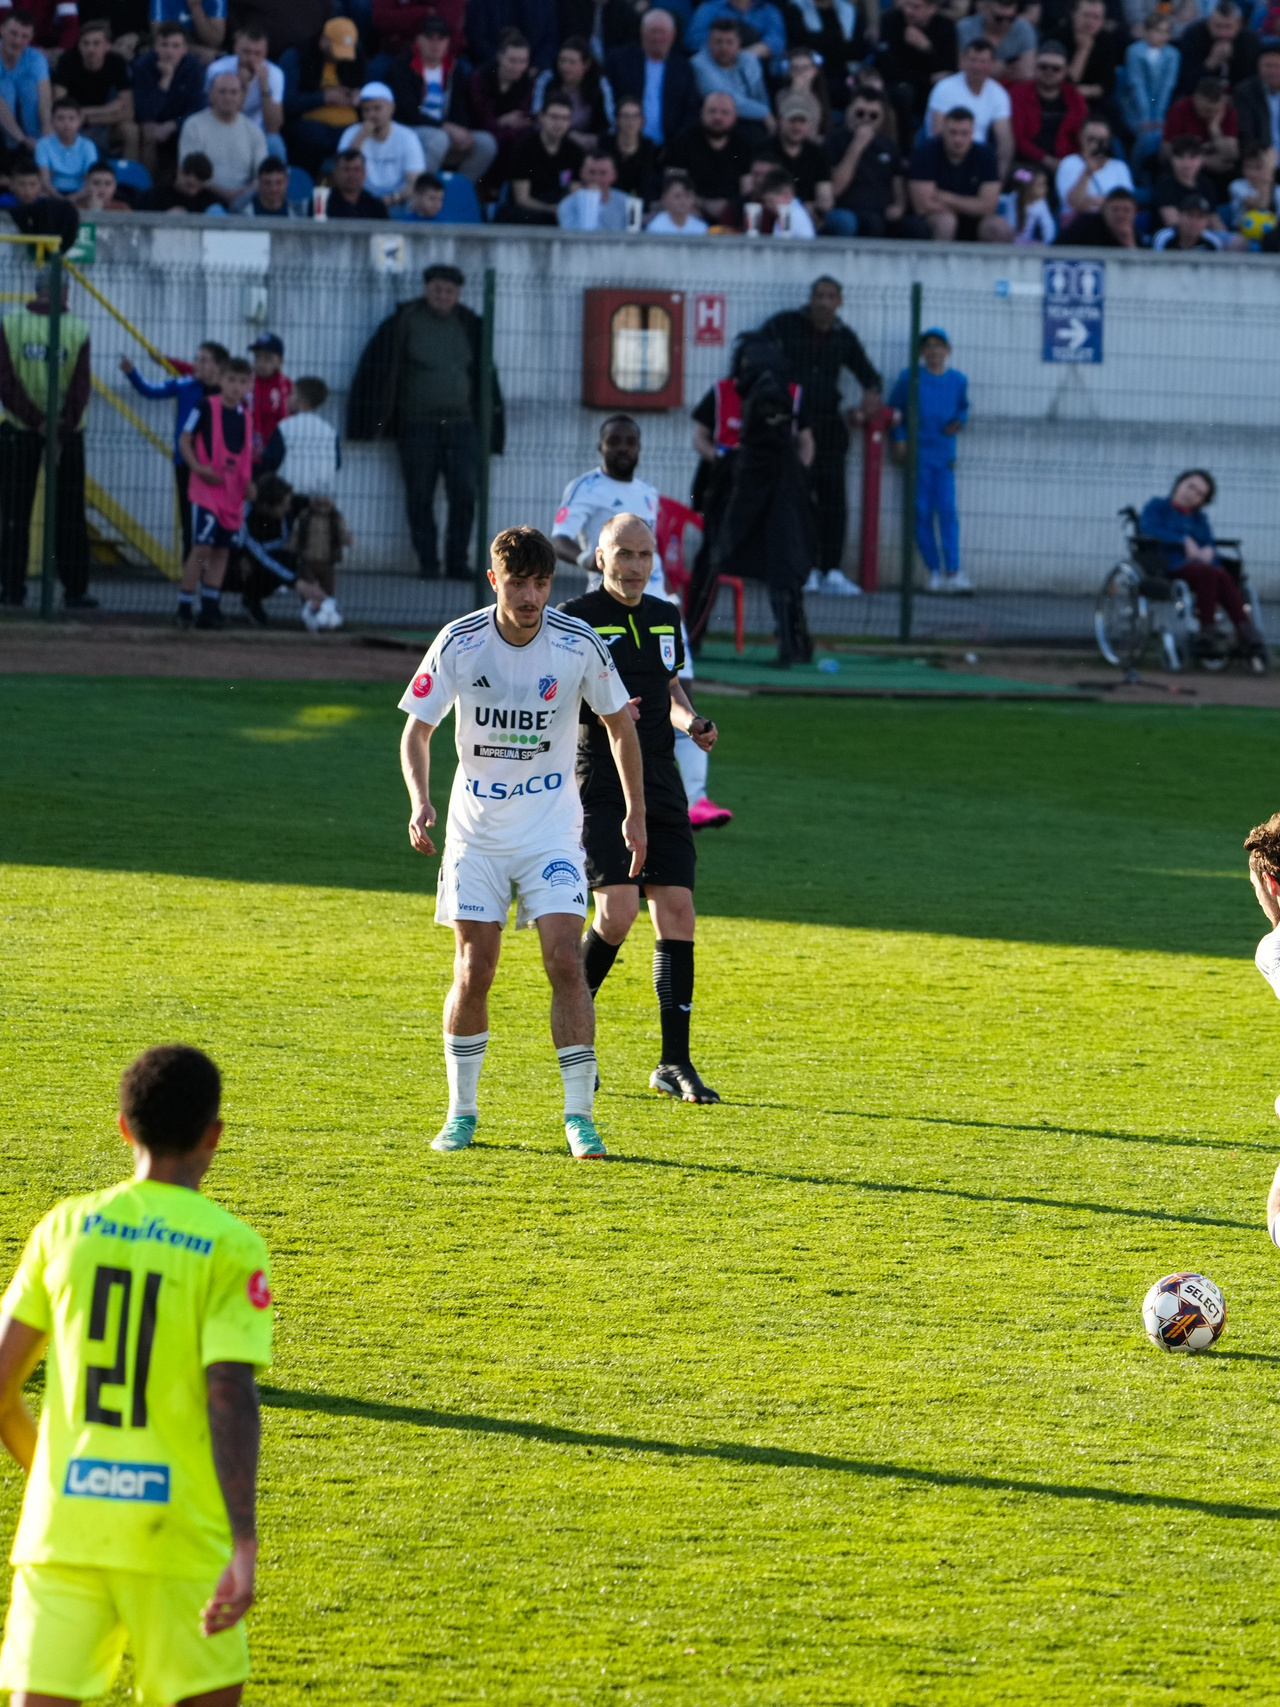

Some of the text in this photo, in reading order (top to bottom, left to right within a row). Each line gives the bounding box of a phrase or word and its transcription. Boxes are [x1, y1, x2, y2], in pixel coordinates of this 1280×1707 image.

[458, 903, 484, 912] Vestra
[83, 1214, 213, 1255] Panifcom
[1184, 1285, 1220, 1318] SELECT
[85, 1265, 162, 1427] 21
[68, 1463, 165, 1495] Leier
